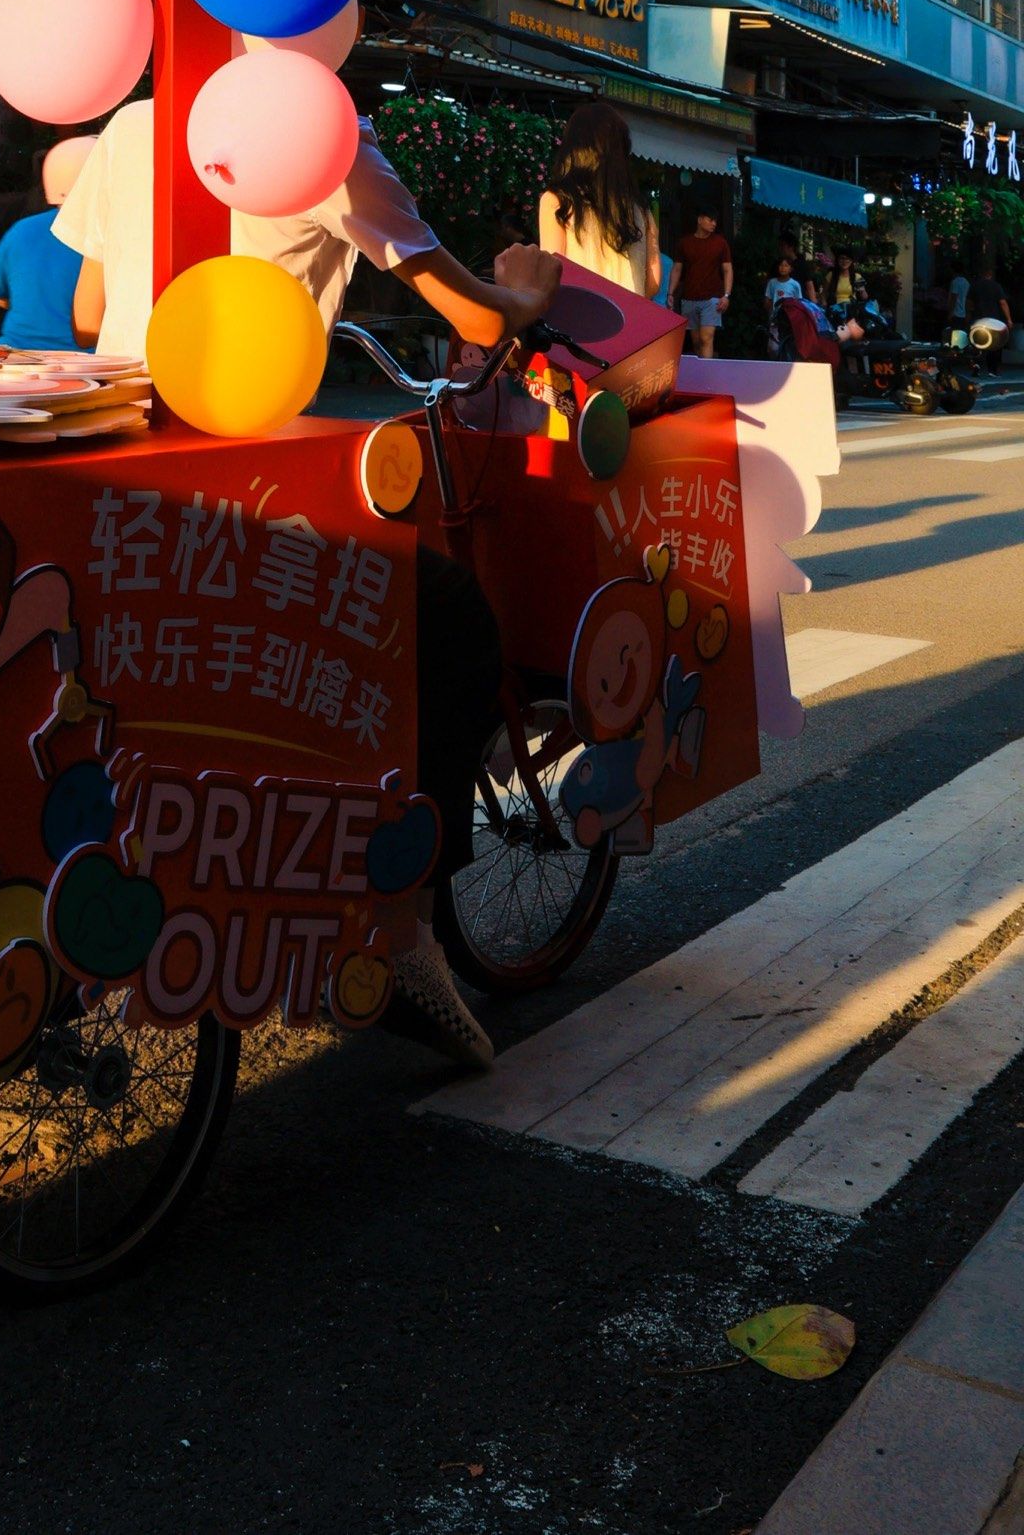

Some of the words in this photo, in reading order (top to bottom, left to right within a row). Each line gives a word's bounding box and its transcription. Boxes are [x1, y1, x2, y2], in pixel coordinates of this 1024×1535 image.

[630, 473, 739, 537] 人生小乐
[87, 486, 394, 651] 轻松拿捏
[92, 612, 393, 752] 快乐手到擒来
[139, 779, 380, 895] PRIZE
[145, 910, 341, 1017] OUT
